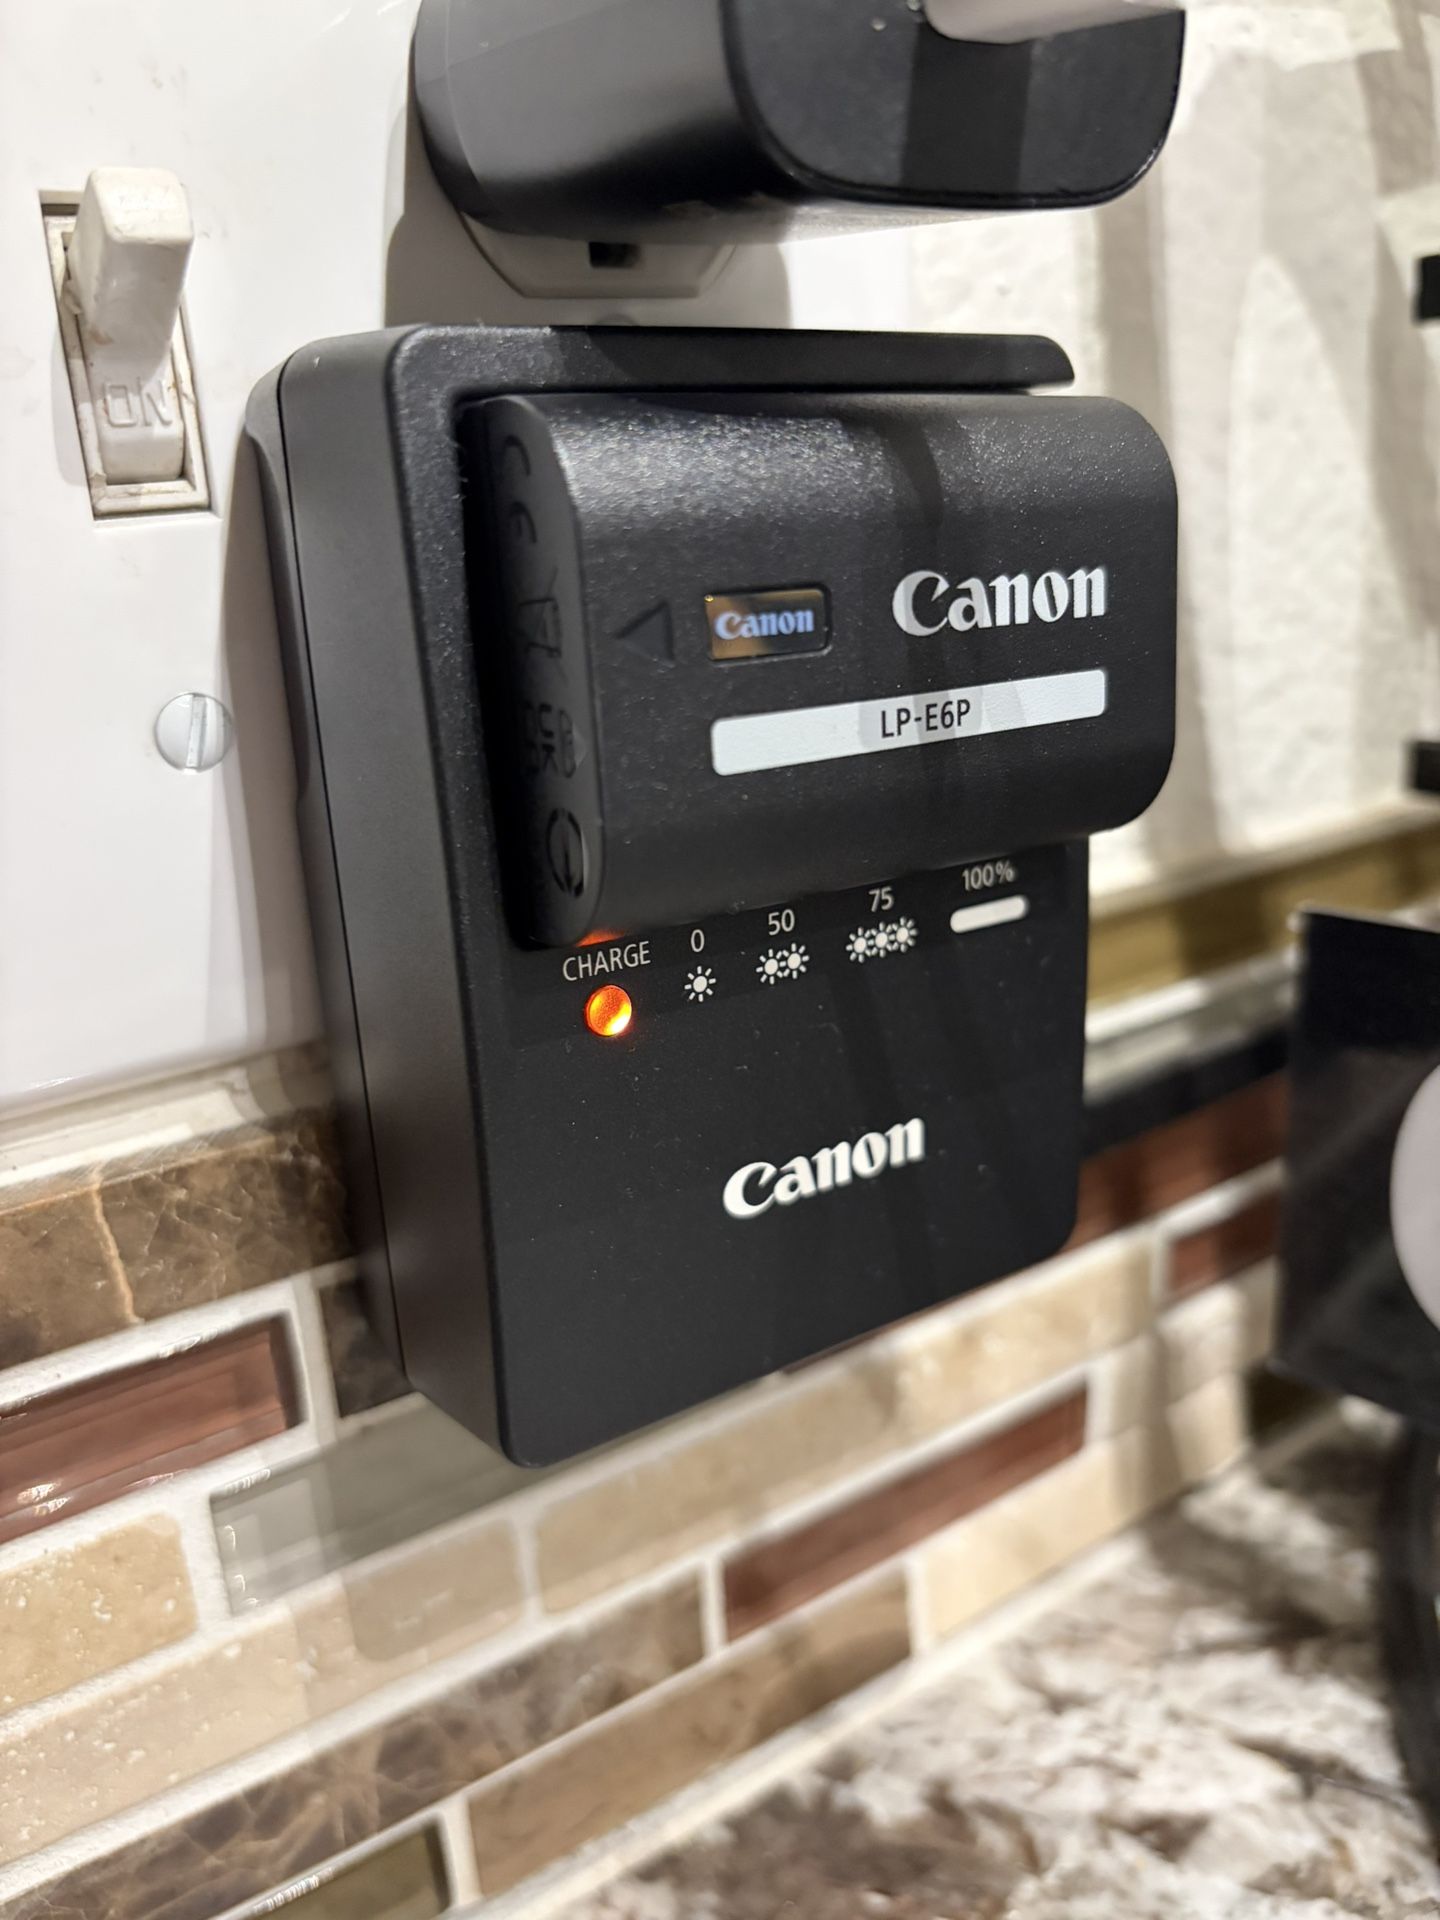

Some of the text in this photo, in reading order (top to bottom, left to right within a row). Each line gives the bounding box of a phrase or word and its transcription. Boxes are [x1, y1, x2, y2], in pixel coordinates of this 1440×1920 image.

[103, 376, 172, 428] ON
[715, 610, 814, 640] Canon
[892, 567, 1107, 637] Canon
[880, 699, 971, 739] LP-E6P
[562, 861, 1015, 982] CHARGE 0 50 75 100%
[723, 1118, 925, 1219] Canon
